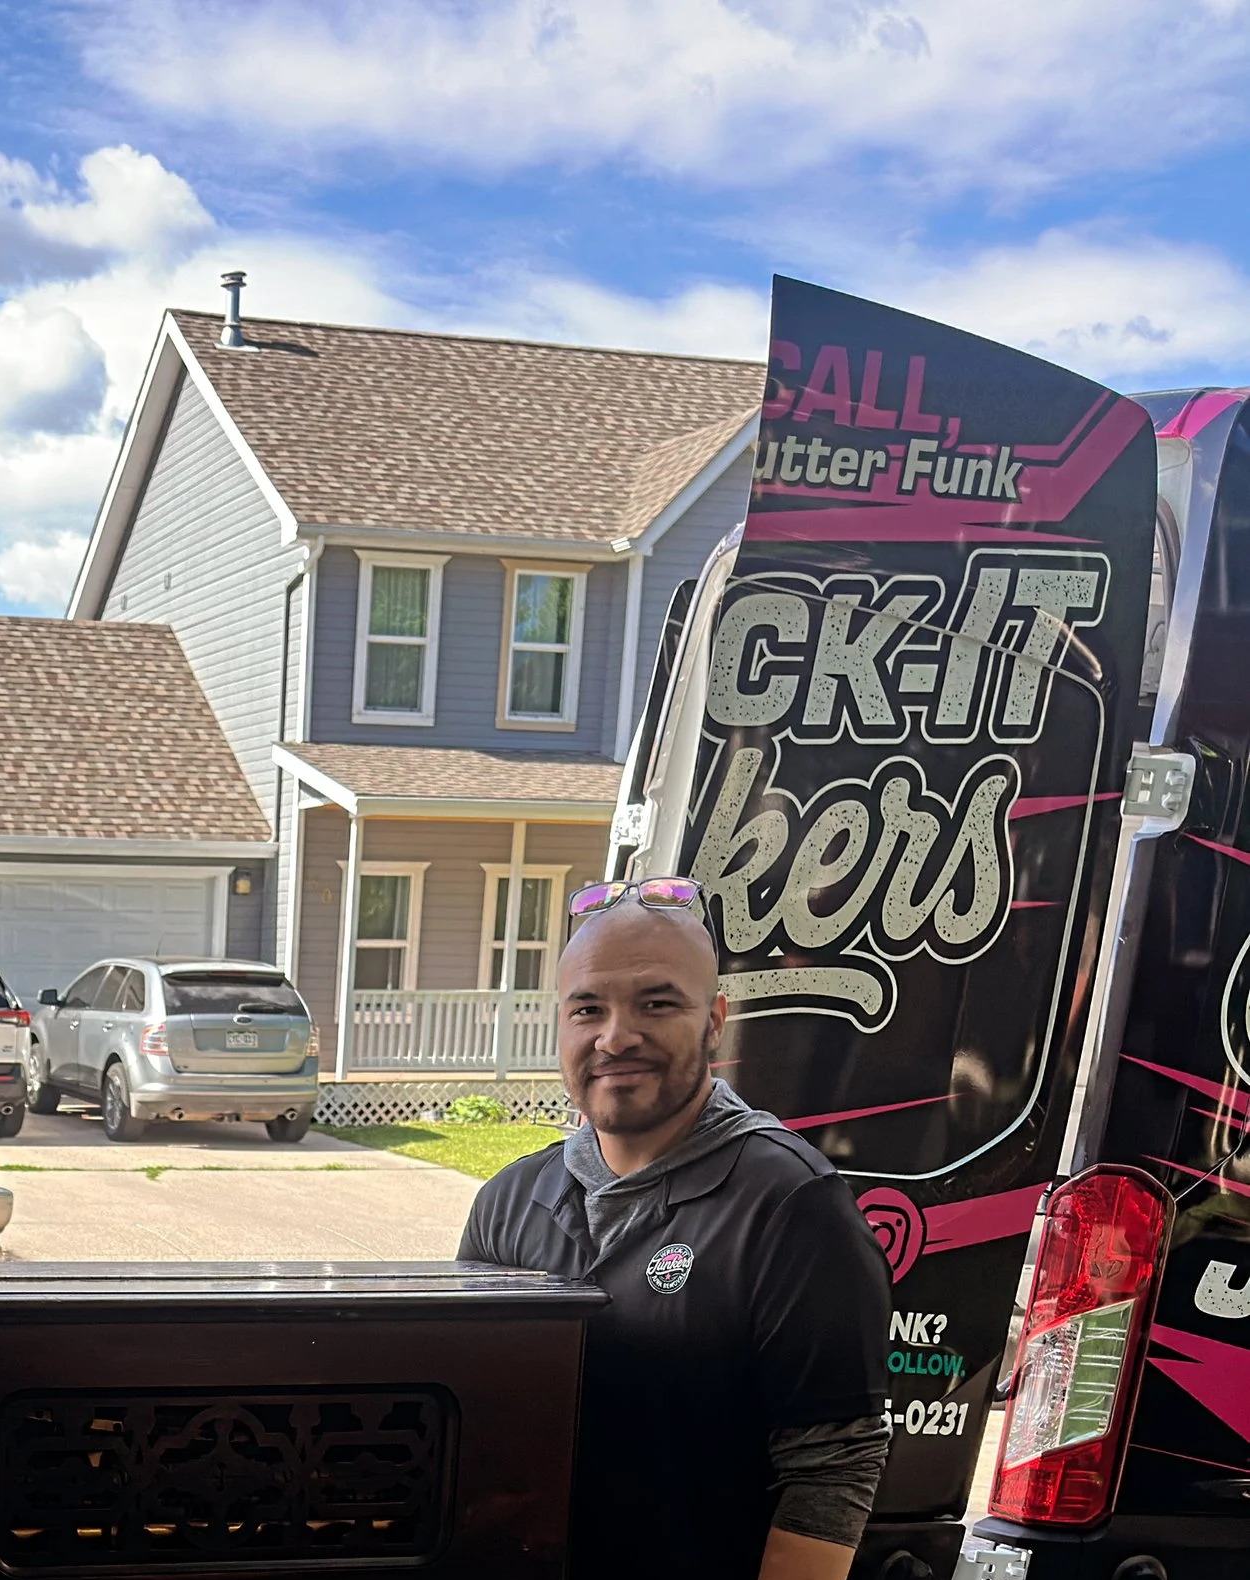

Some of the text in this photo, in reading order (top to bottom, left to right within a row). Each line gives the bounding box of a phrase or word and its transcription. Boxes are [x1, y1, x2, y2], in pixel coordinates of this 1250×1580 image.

[901, 438, 1023, 499] Funk
[706, 567, 1100, 727] CK-IT
[689, 747, 1008, 954] kers
[647, 1256, 694, 1275] Junkers
[889, 1310, 948, 1345] NK?
[887, 1351, 966, 1378] OLLOW.
